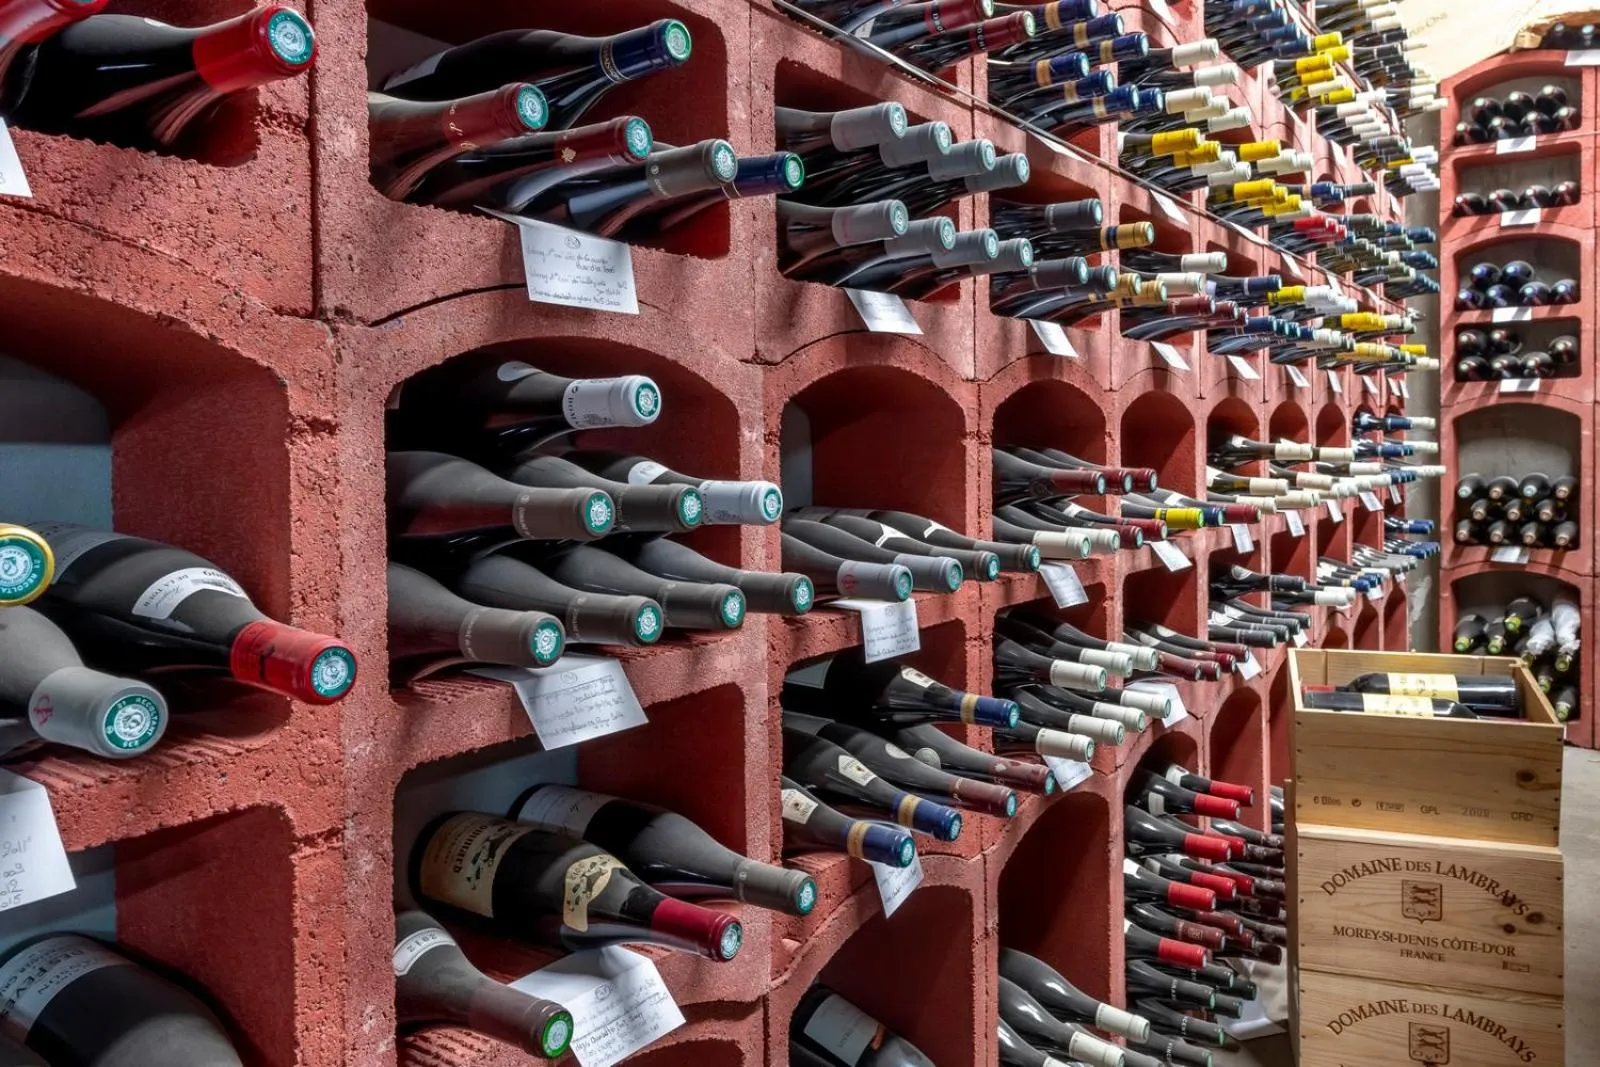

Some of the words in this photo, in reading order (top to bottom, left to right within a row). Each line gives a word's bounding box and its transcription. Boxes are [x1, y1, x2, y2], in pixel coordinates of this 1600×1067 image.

[1321, 857, 1402, 896] DOMAINE
[1405, 860, 1432, 873] DES
[1435, 860, 1530, 916] LAMBRAYS
[1400, 948, 1447, 963] FRANCE
[1441, 937, 1516, 958] CÔTE-D'OR
[1326, 999, 1409, 1036] DOMAINE
[1412, 1003, 1439, 1016] DES
[1442, 1003, 1537, 1064] LAMBRAYS
